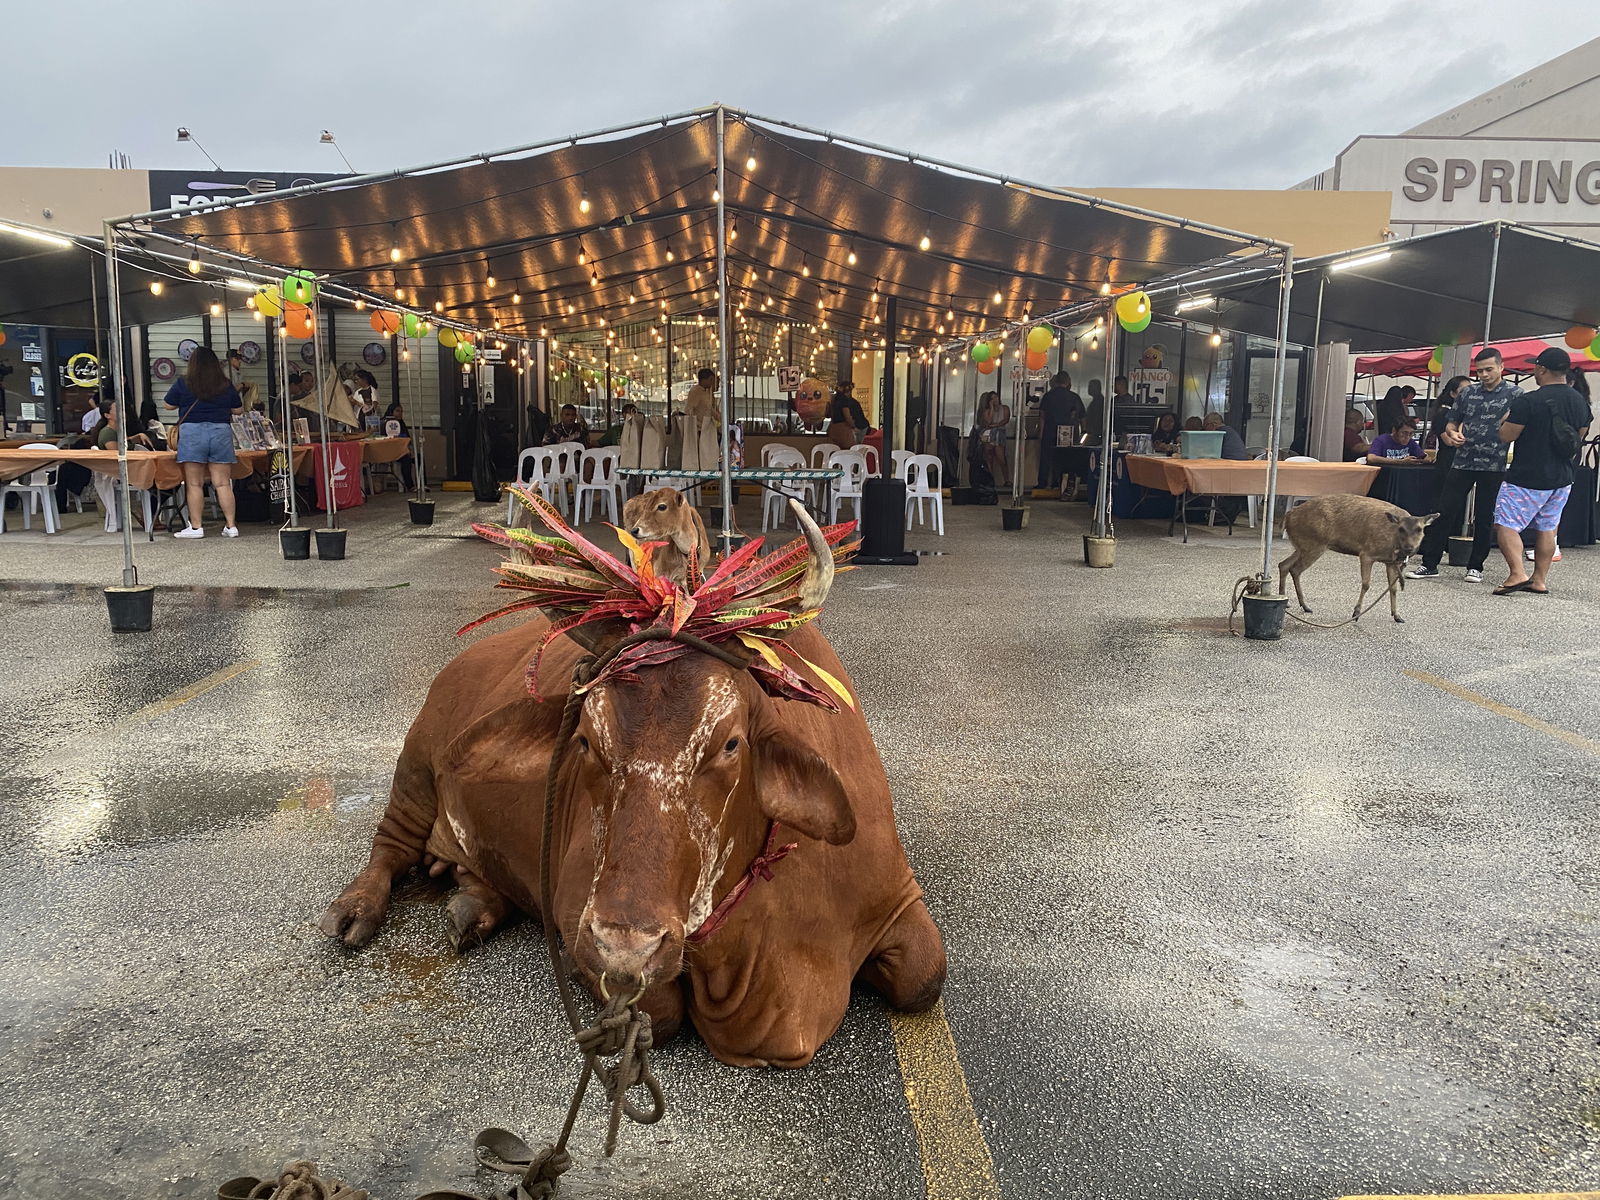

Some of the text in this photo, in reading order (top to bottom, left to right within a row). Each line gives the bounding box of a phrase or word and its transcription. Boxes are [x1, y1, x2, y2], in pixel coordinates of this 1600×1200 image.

[1009, 370, 1052, 380] MNGO
[1130, 371, 1172, 382] MANGO
[485, 391, 492, 399] A
